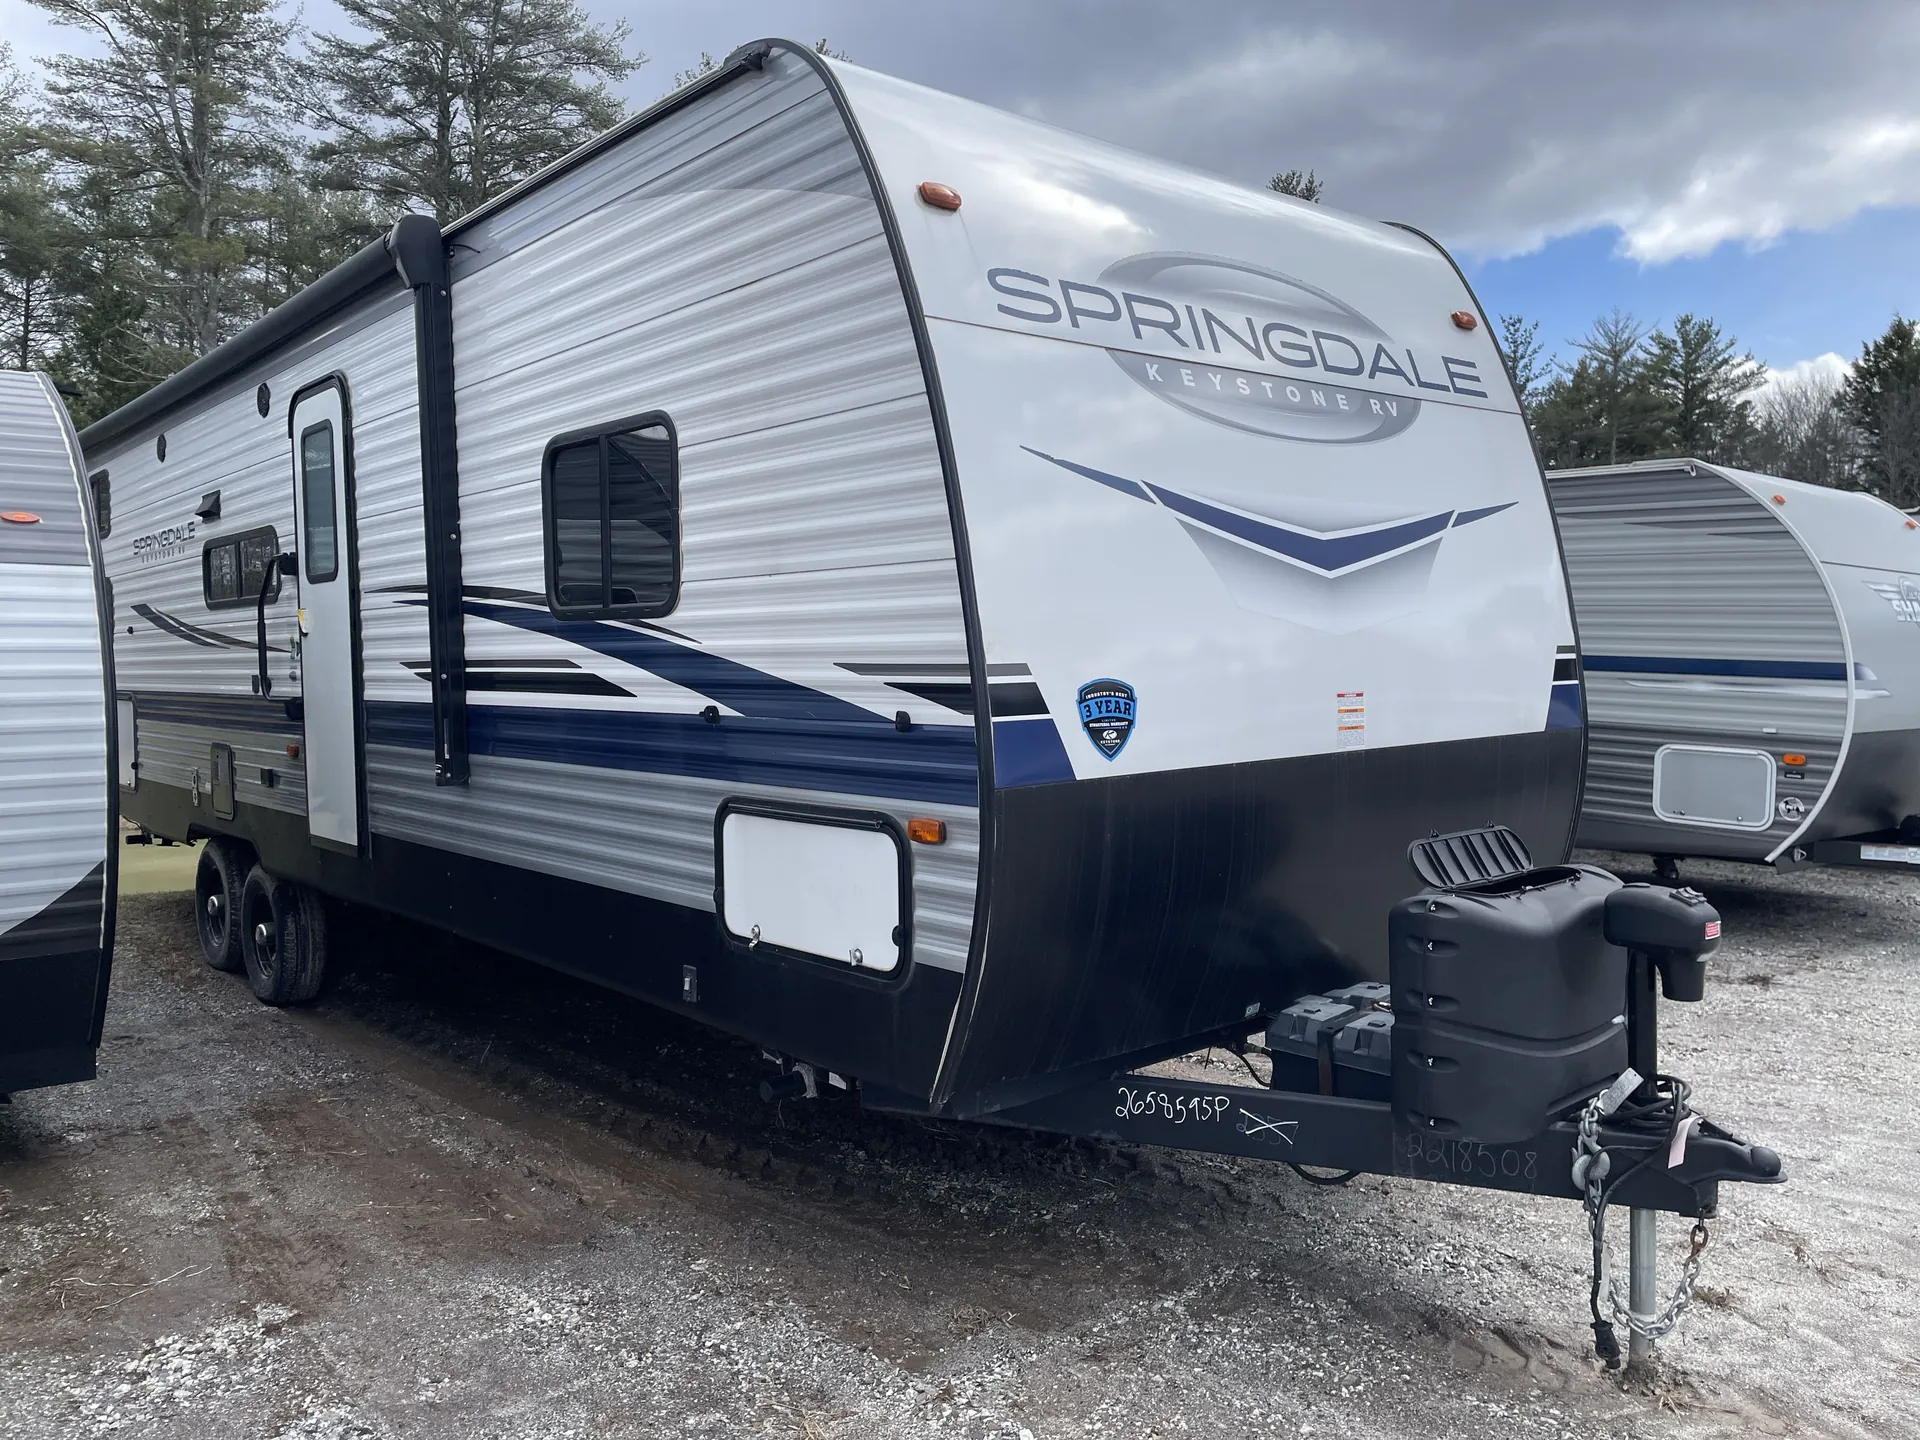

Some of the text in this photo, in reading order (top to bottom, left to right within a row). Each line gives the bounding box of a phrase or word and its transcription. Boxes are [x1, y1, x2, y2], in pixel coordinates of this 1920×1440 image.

[987, 267, 1488, 398] SPRINGDALE
[1146, 362, 1399, 417] KEYSTONE RV
[133, 521, 196, 555] SPRINGDALE
[1084, 700, 1131, 718] 3 YEAR
[1115, 1087, 1230, 1123] 2658595P
[1405, 1133, 1538, 1180] 2218508
